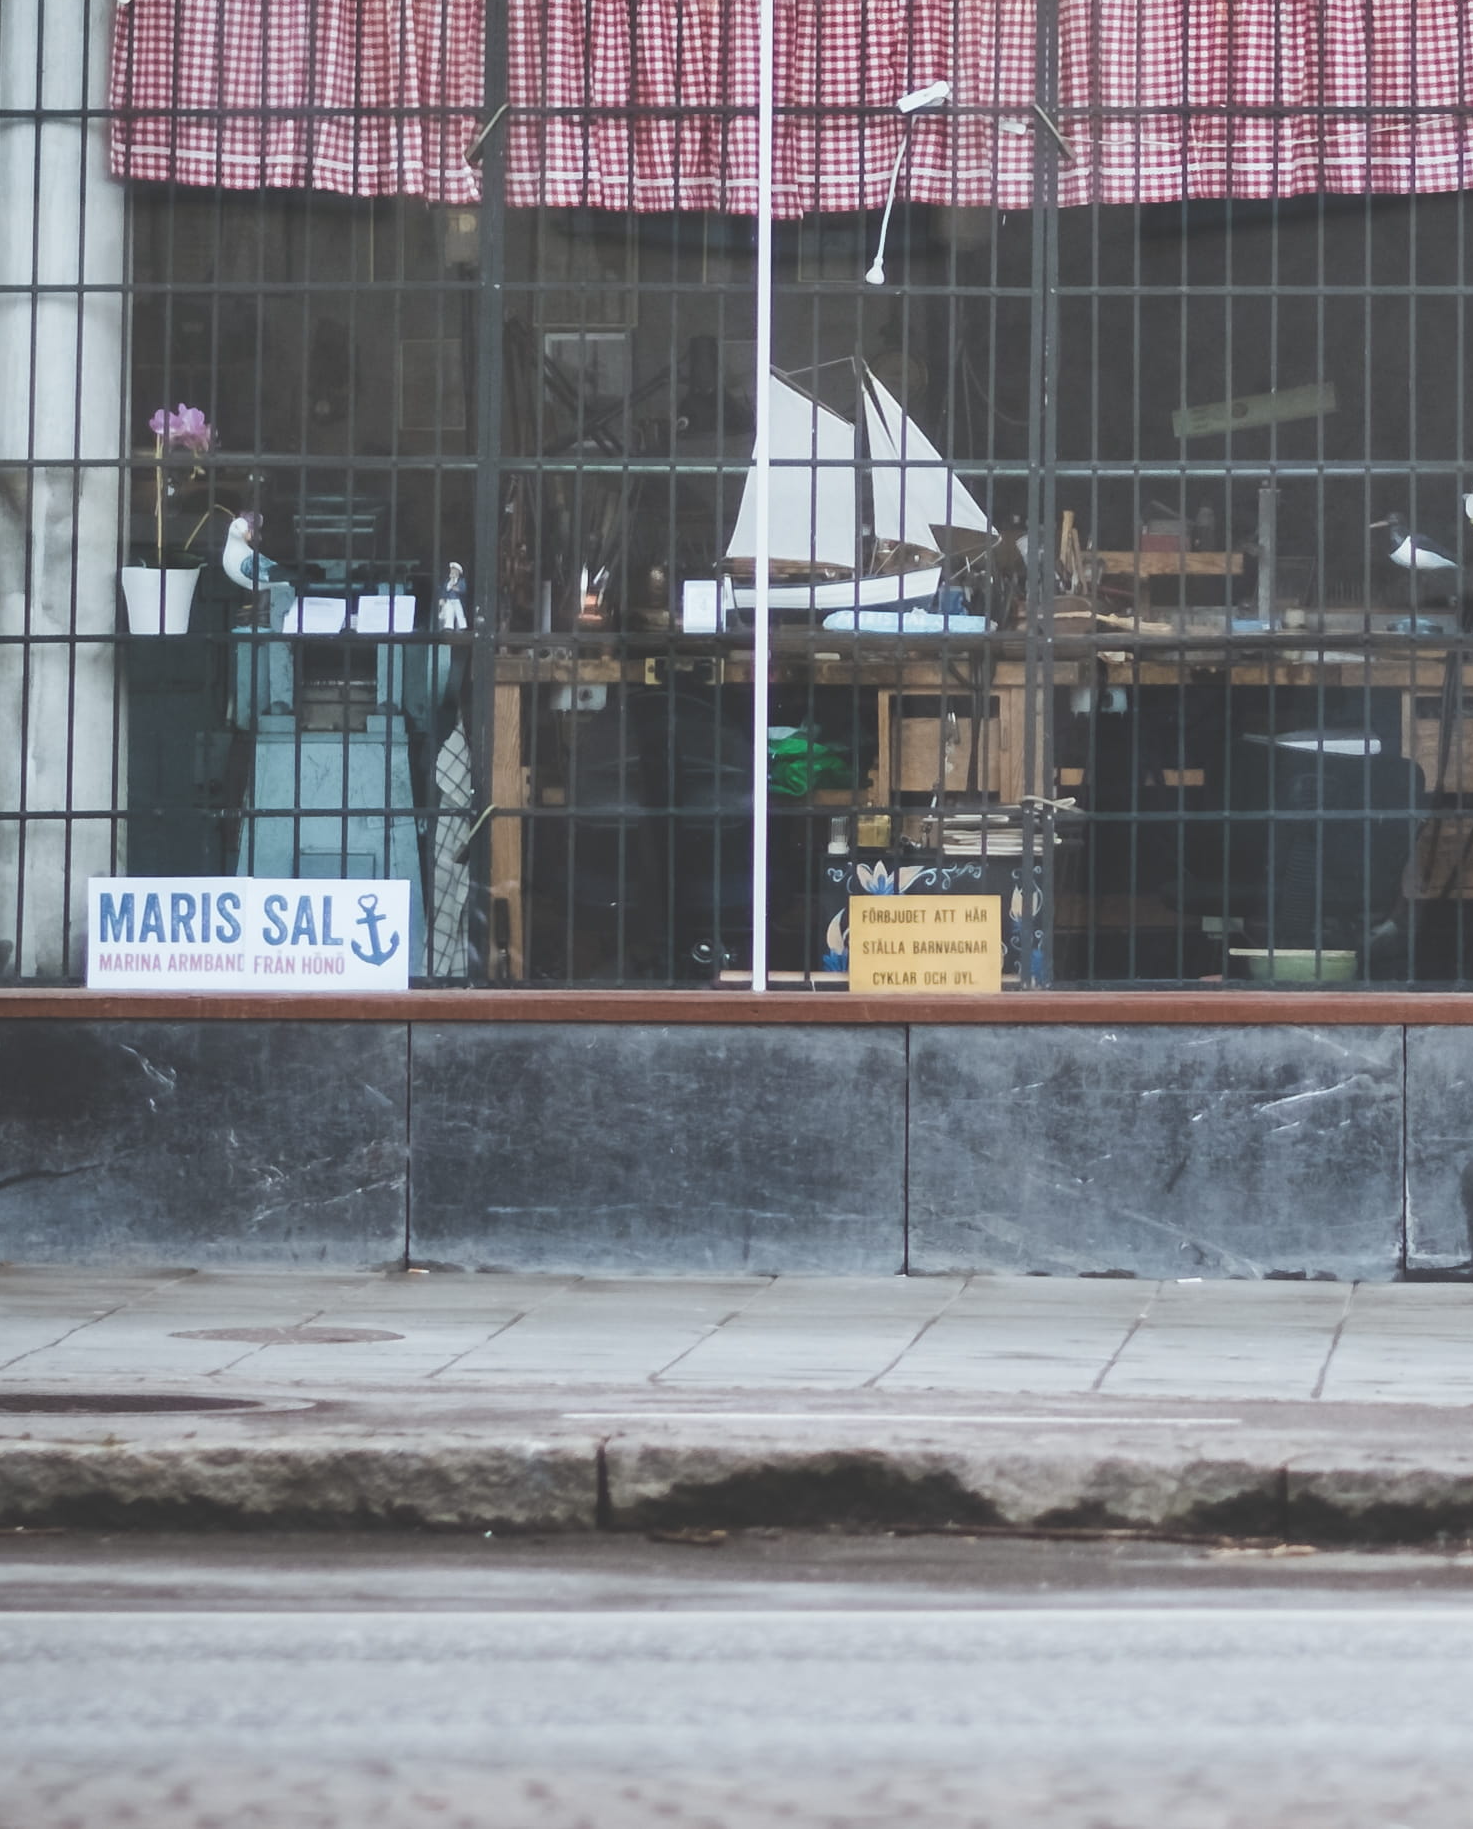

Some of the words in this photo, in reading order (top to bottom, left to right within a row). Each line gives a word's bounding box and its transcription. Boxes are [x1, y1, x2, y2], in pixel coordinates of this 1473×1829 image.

[99, 892, 243, 944] MARIS
[262, 894, 344, 946] SAL
[861, 907, 926, 924] FÖRBJUDET
[934, 909, 957, 923] ATT
[965, 906, 988, 923] HÄR
[862, 938, 906, 956] STÄLLA
[912, 940, 988, 955] BARNVAGNAR
[98, 953, 161, 972] MARINA
[253, 949, 296, 974] FRÅN
[301, 950, 346, 975] HÖNÖ
[872, 971, 918, 986] CYKLAR
[925, 972, 948, 985] OCH
